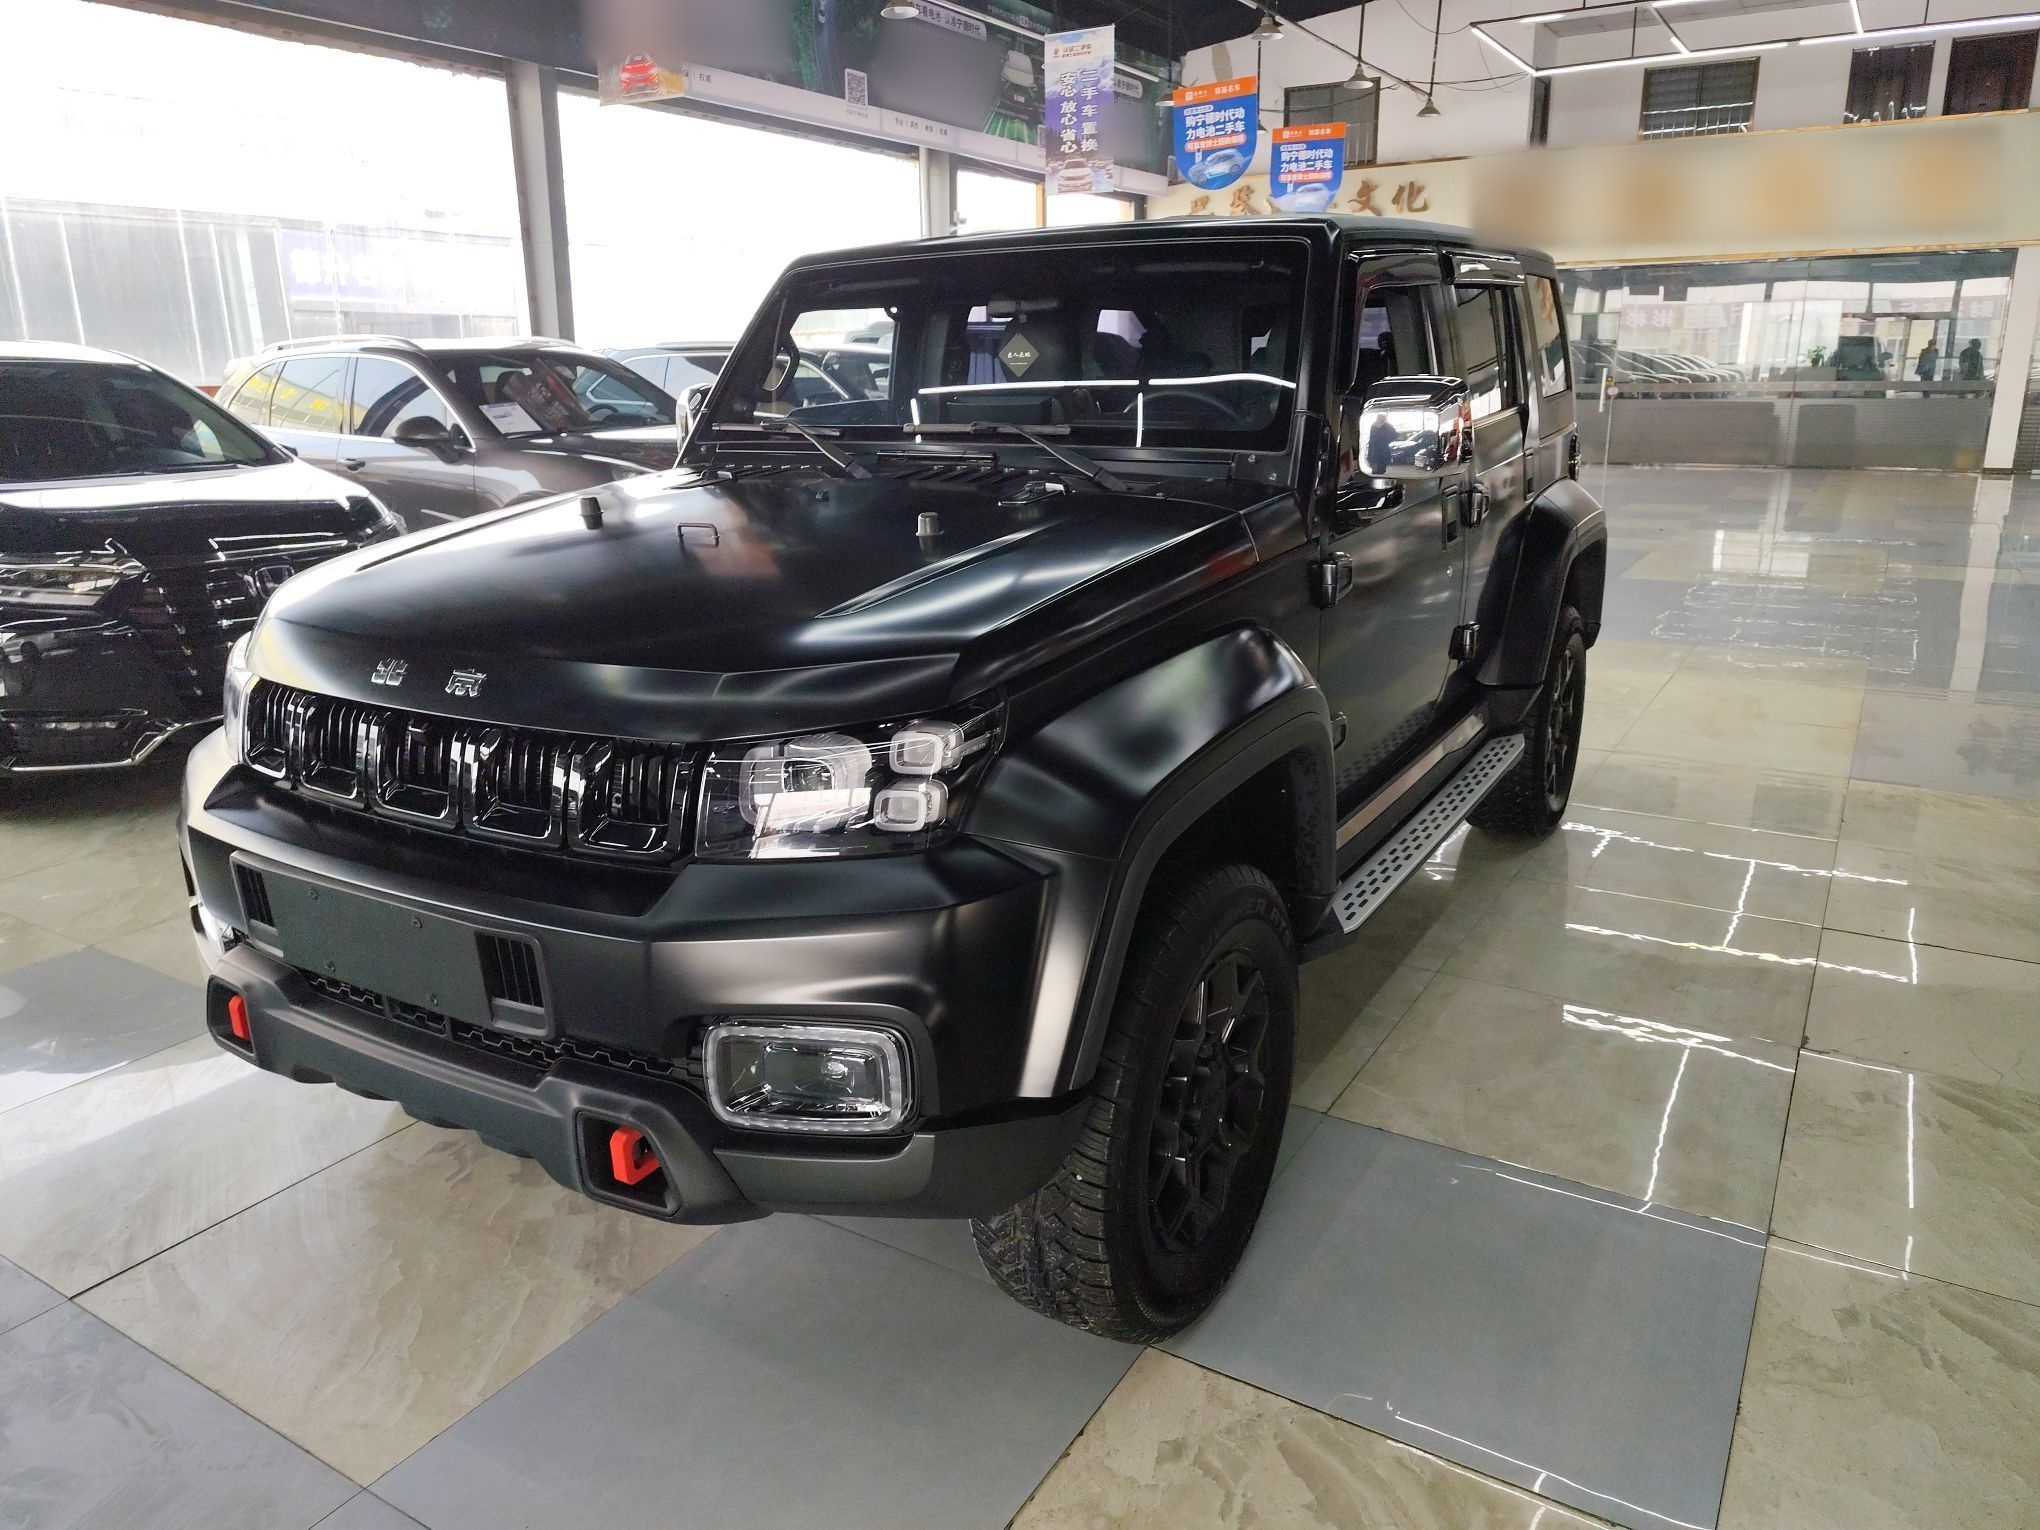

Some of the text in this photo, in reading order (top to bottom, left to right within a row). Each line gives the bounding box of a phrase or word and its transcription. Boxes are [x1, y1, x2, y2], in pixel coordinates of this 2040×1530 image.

[1081, 69, 1099, 152] 二手车置换
[1185, 107, 1245, 127] 购宁德时代动
[1185, 121, 1245, 140] 力电池二手车
[1281, 148, 1333, 161] 购宁德时代动
[1280, 160, 1333, 172] 力电池二手车
